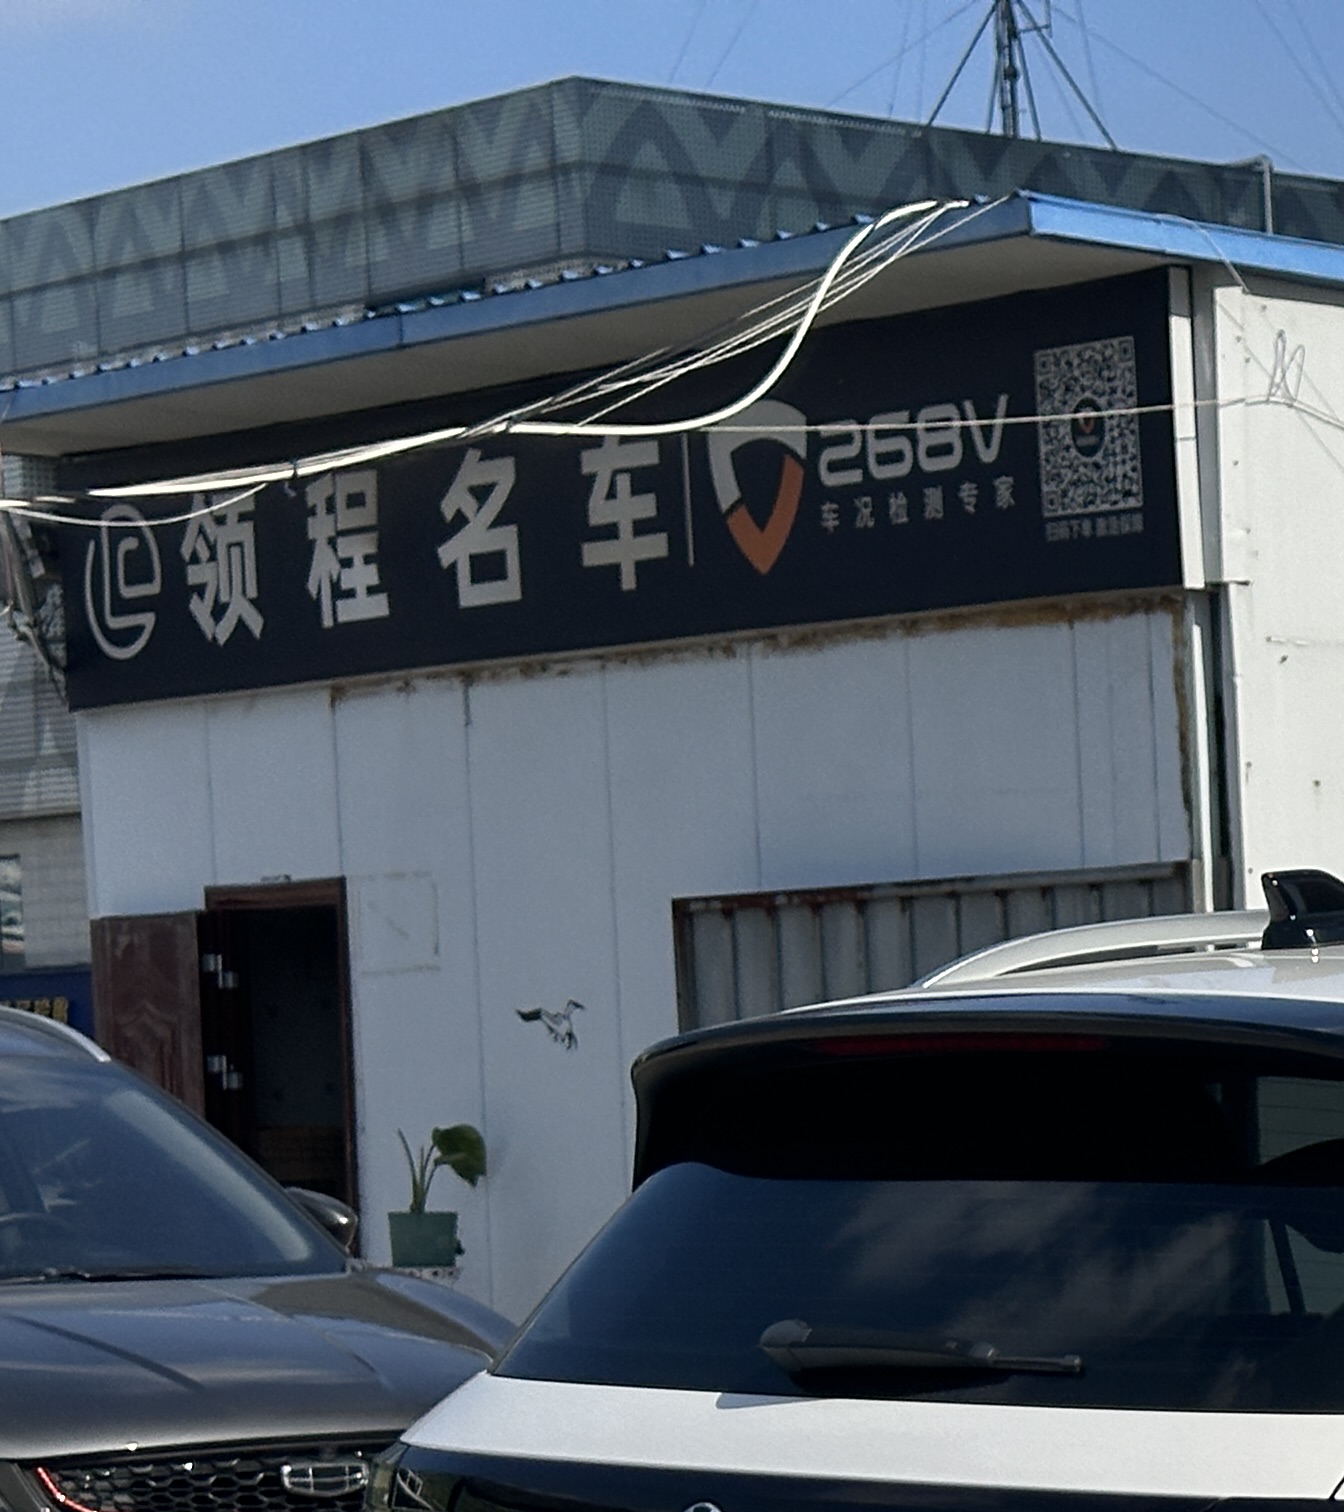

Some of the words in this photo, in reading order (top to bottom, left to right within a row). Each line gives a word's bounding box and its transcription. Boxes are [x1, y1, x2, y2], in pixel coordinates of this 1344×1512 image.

[818, 392, 1010, 488] 268V
[179, 434, 668, 647] 领程名车
[820, 475, 1015, 532] 车况检测专家
